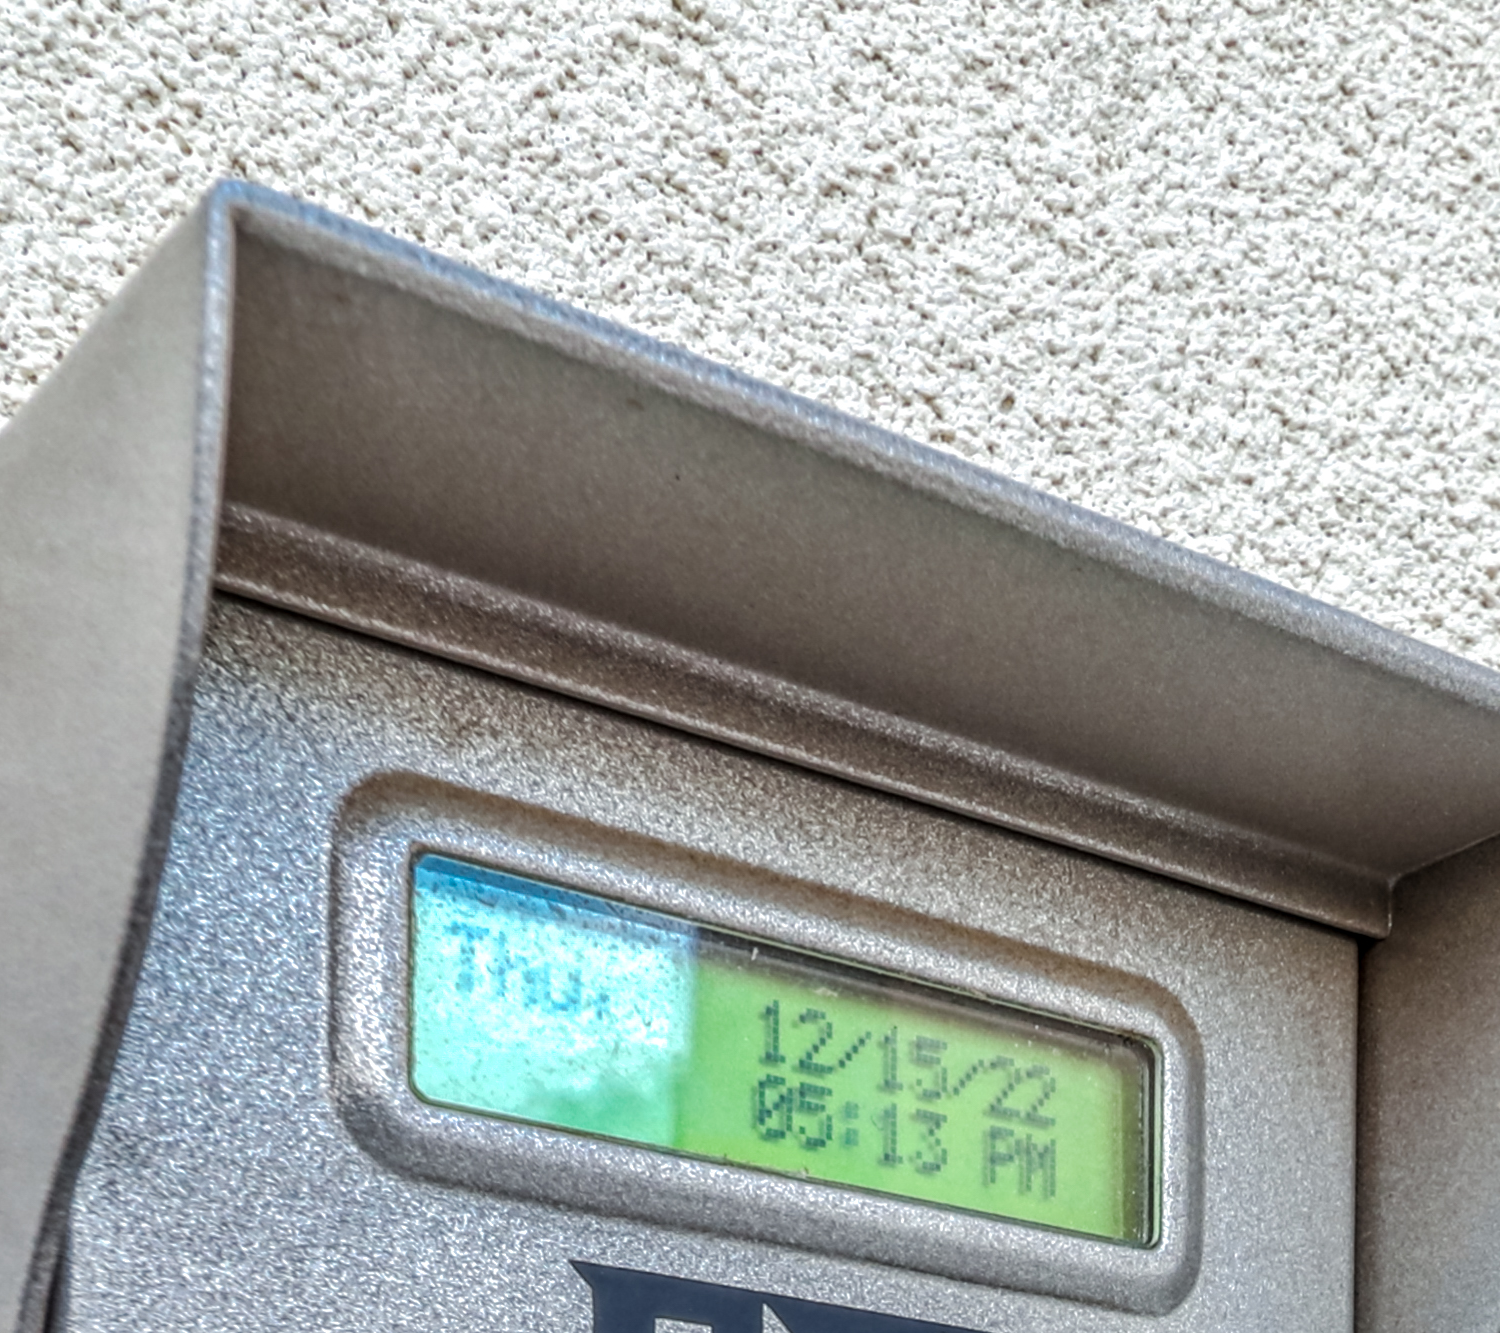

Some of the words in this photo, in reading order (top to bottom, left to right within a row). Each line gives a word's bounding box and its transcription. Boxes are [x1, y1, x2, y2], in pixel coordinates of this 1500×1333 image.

[759, 1000, 1056, 1128] 12/15/22
[755, 1073, 948, 1177] 05:13
[987, 1124, 1056, 1198] PM
